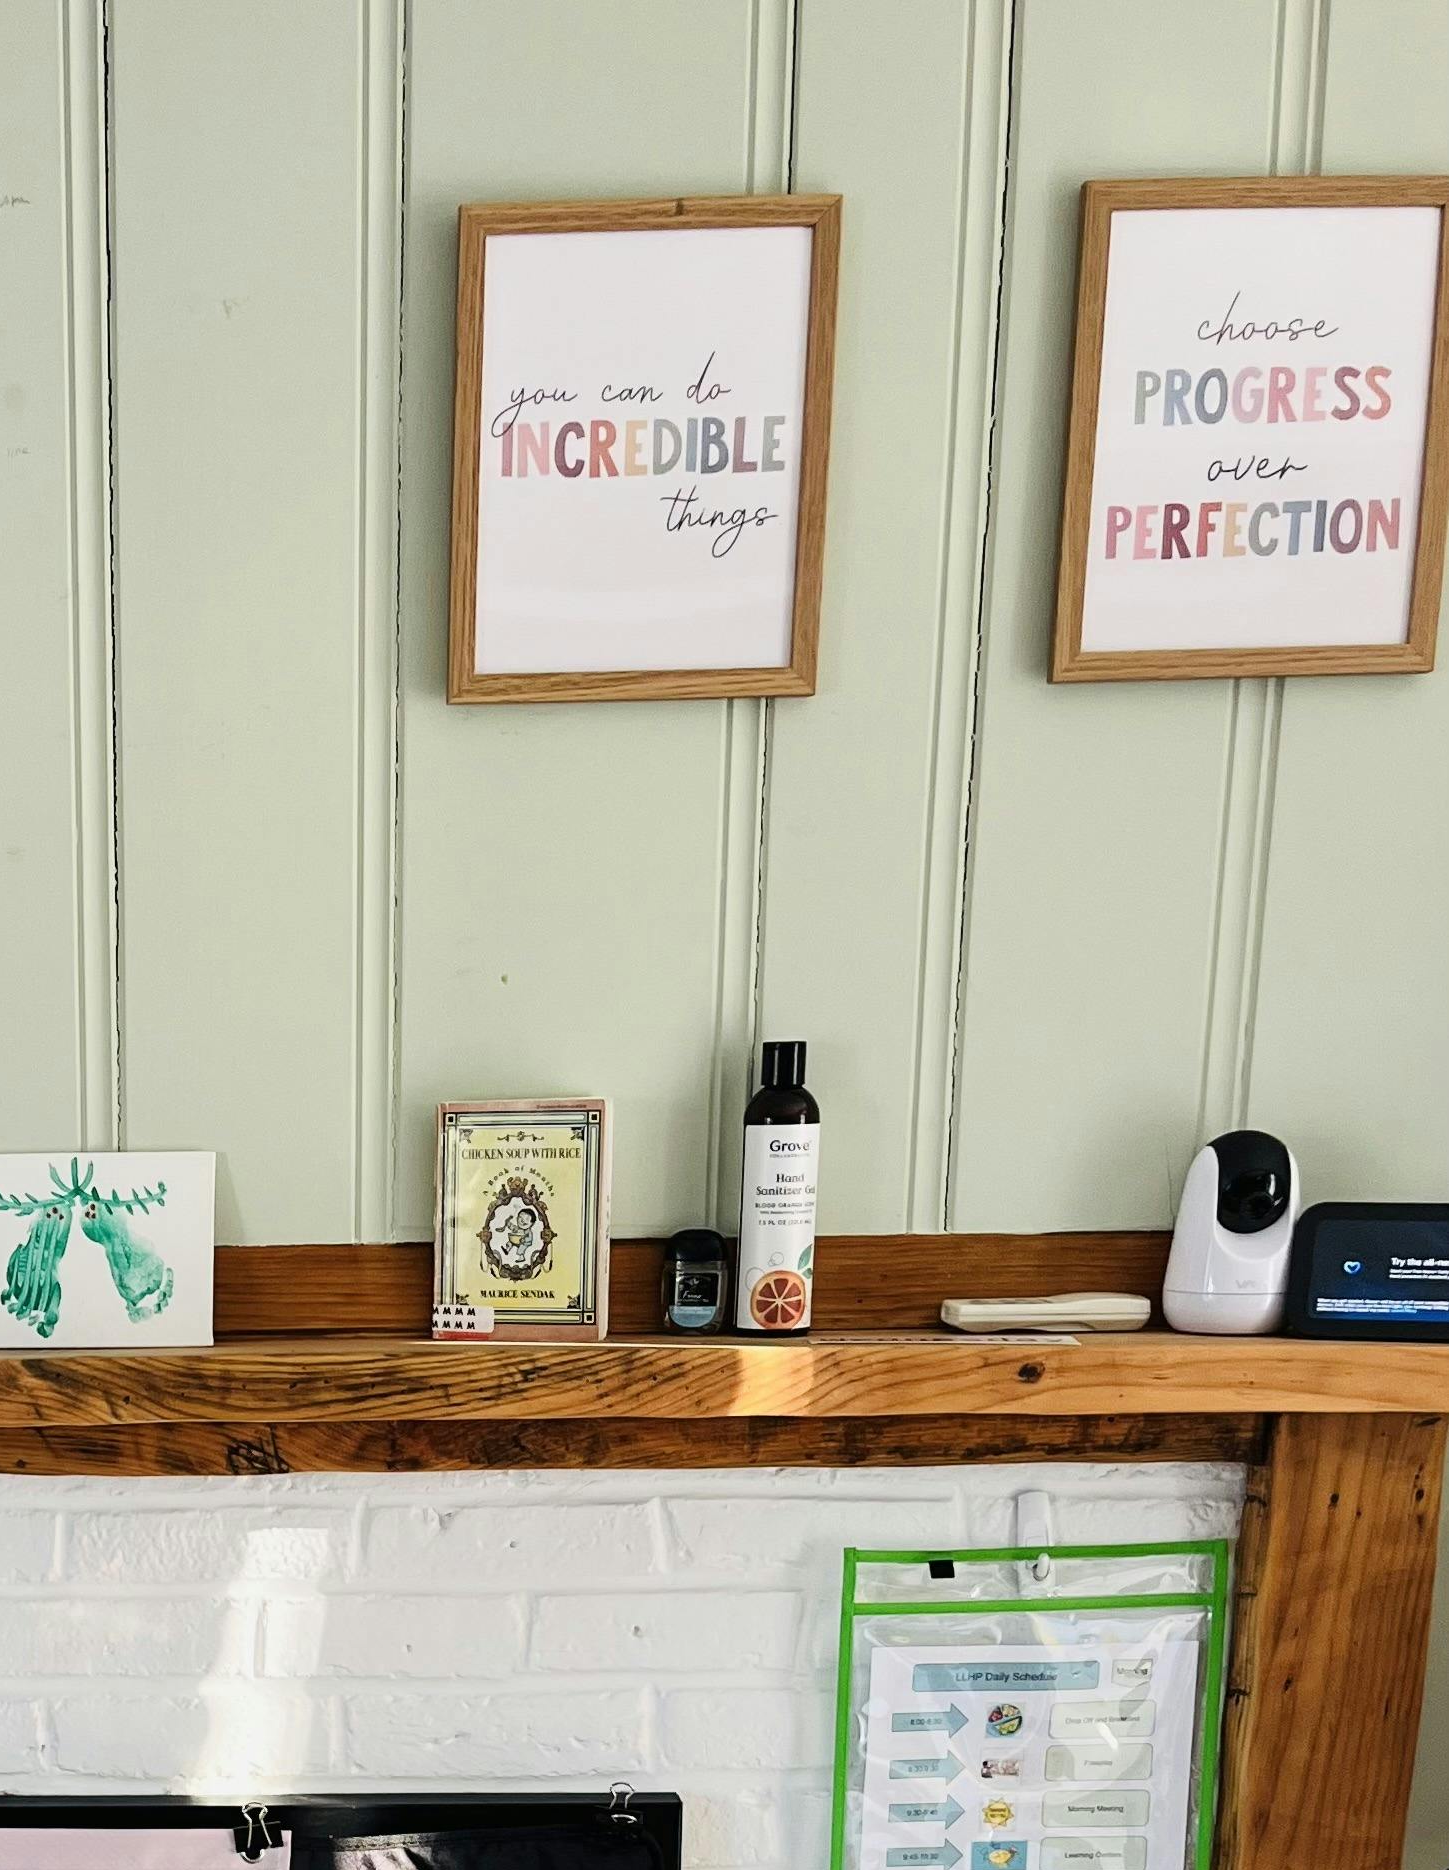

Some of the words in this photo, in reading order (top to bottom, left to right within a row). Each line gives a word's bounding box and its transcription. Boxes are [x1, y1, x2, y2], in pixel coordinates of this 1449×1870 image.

[1196, 290, 1340, 346] choose
[491, 385, 578, 438] you
[601, 383, 664, 403] can
[686, 350, 732, 403] do
[1134, 366, 1393, 427] PROGRESS
[500, 415, 787, 479] INCREDIBLE
[1206, 454, 1309, 482] over
[660, 485, 778, 559] things
[1104, 497, 1401, 561] PERFECTION
[461, 1149, 504, 1160] CHICKEN
[505, 1148, 530, 1160] SOUP
[530, 1148, 557, 1159] WITH
[558, 1147, 581, 1158] RICE
[769, 1139, 810, 1152] Grove
[776, 1173, 805, 1183] Hand
[756, 1186, 802, 1196] Sanitizer
[1391, 1257, 1406, 1267] Try
[480, 1290, 518, 1299] MAURICE
[520, 1290, 555, 1299] SENDAK
[955, 1673, 983, 1682] LLHP
[985, 1671, 1009, 1684] Daily
